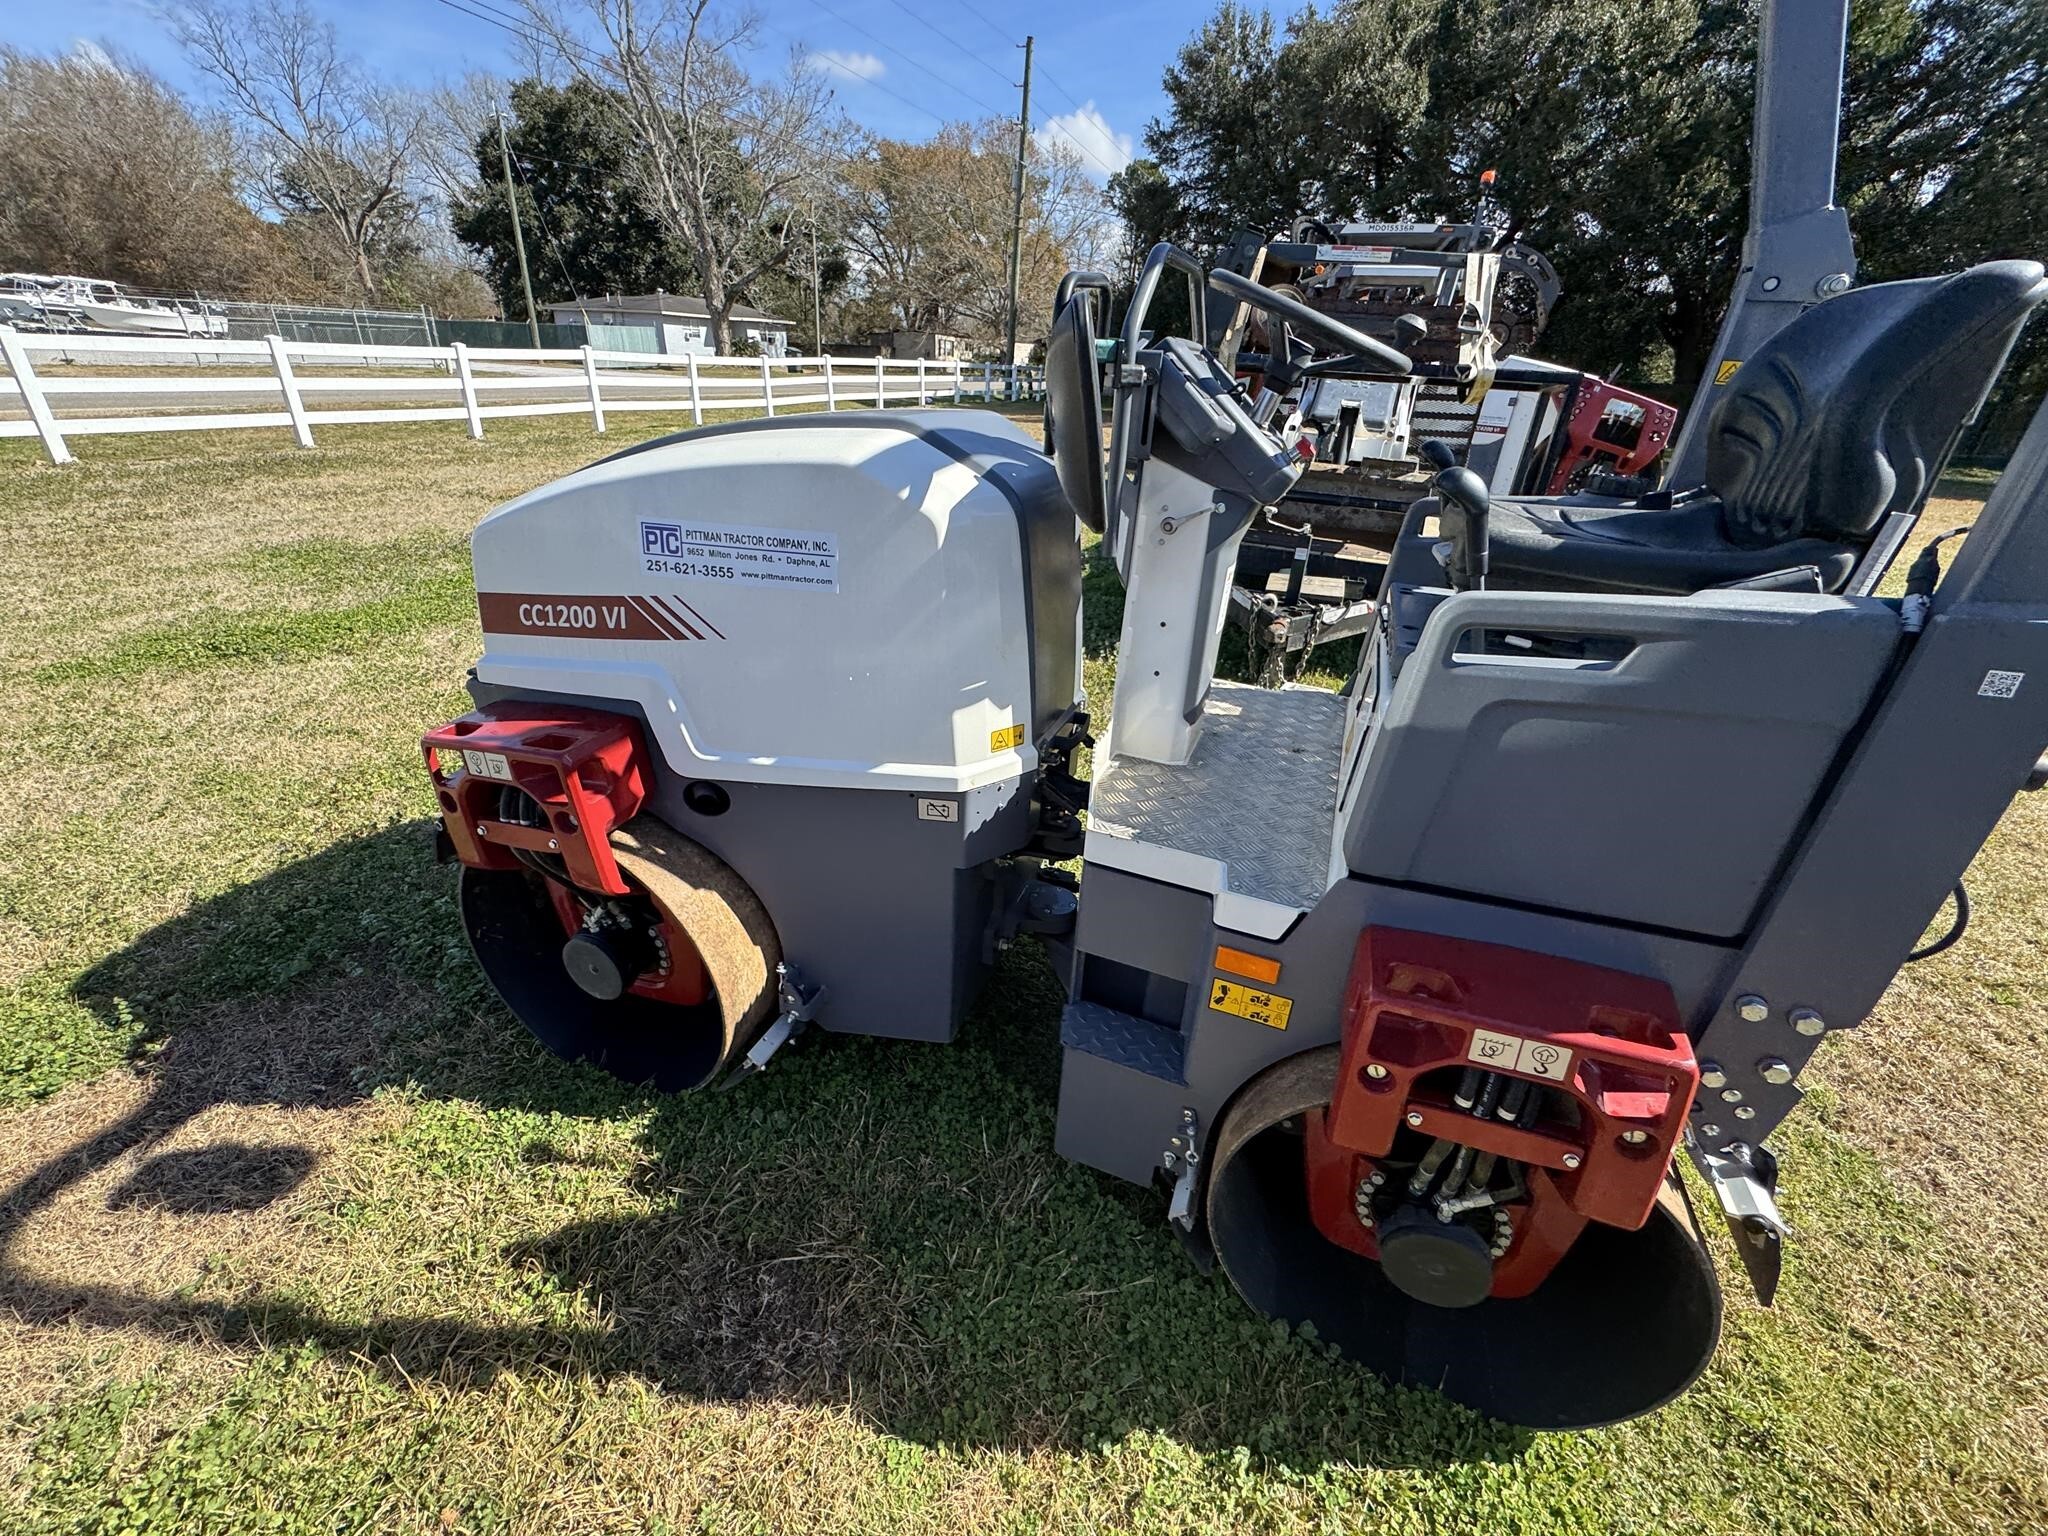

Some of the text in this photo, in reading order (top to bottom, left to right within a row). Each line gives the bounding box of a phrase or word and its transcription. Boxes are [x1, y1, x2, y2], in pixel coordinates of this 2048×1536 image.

[645, 525, 680, 554] PTC
[685, 529, 831, 553] PITTMAN TRACTOR COMPANY, INC.
[686, 547, 831, 568] 9652 Milton Jones Rd. Daphne, AL
[646, 560, 735, 579] 251-621-3555
[741, 571, 833, 586] www.pittmantractor.com
[519, 603, 627, 630] CC1200 VI
